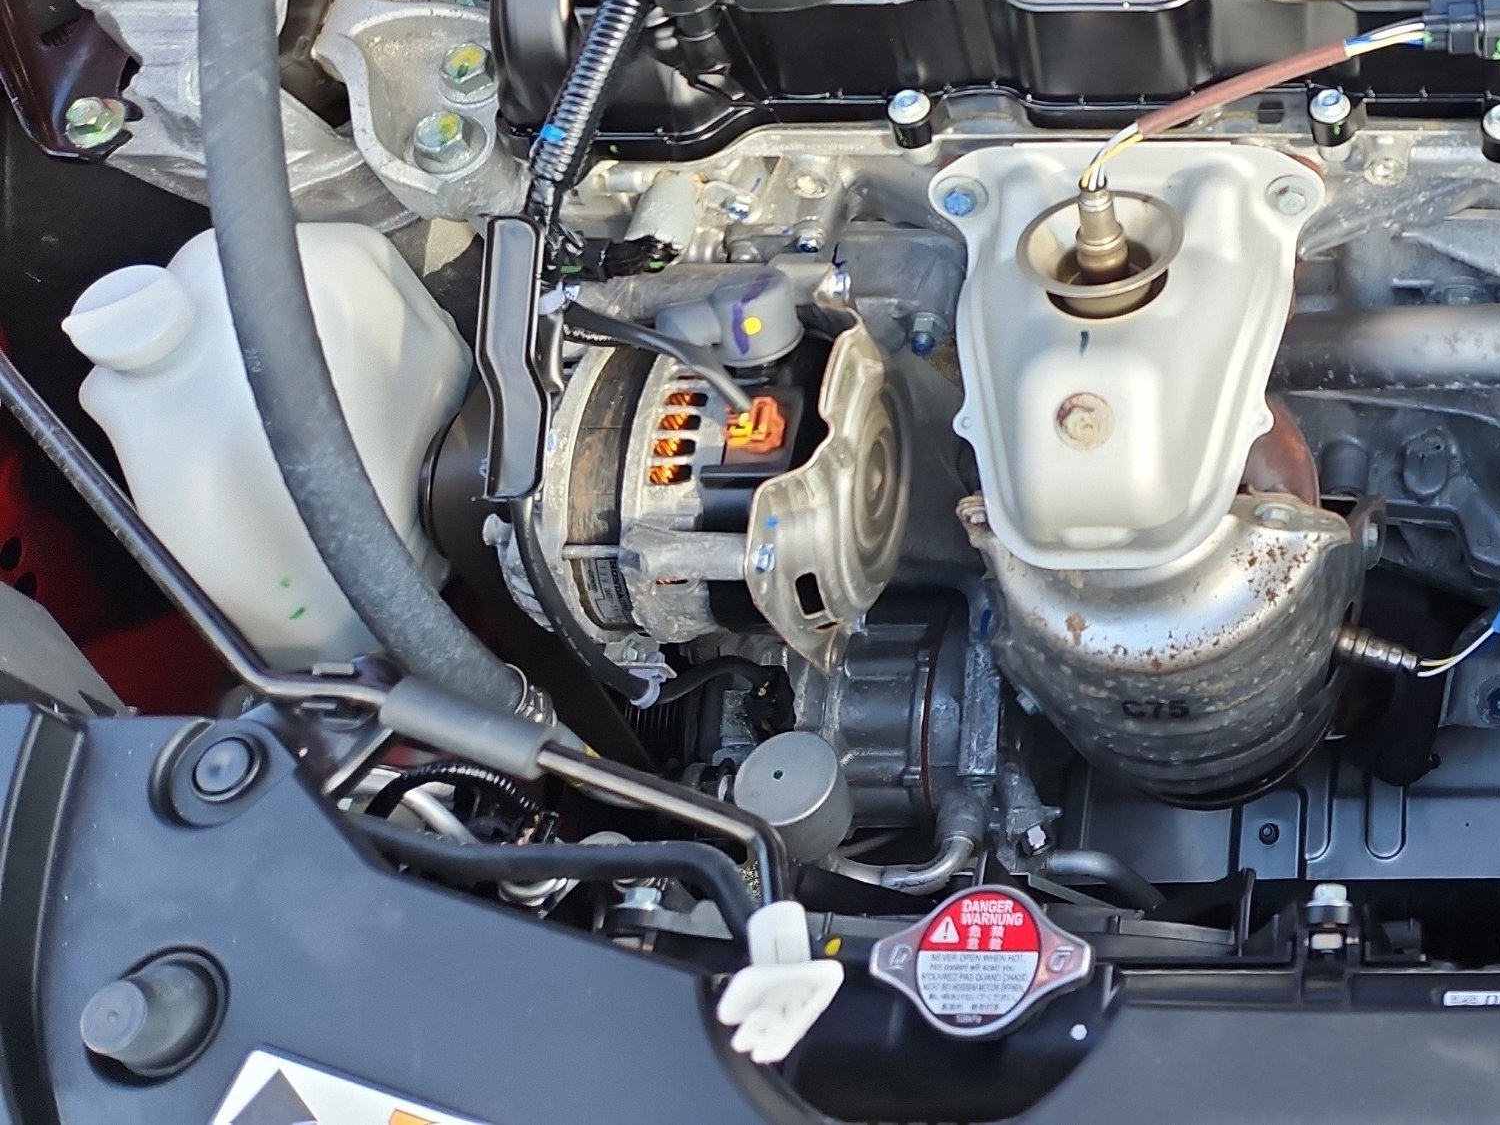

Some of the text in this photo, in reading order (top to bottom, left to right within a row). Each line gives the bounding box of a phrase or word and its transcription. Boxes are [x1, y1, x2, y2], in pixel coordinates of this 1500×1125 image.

[609, 559, 624, 598] HONDA
[962, 899, 1014, 913] DANGER
[961, 912, 1024, 926] WARNUNG
[959, 954, 982, 962] OPEN
[983, 954, 1006, 962] WHEN
